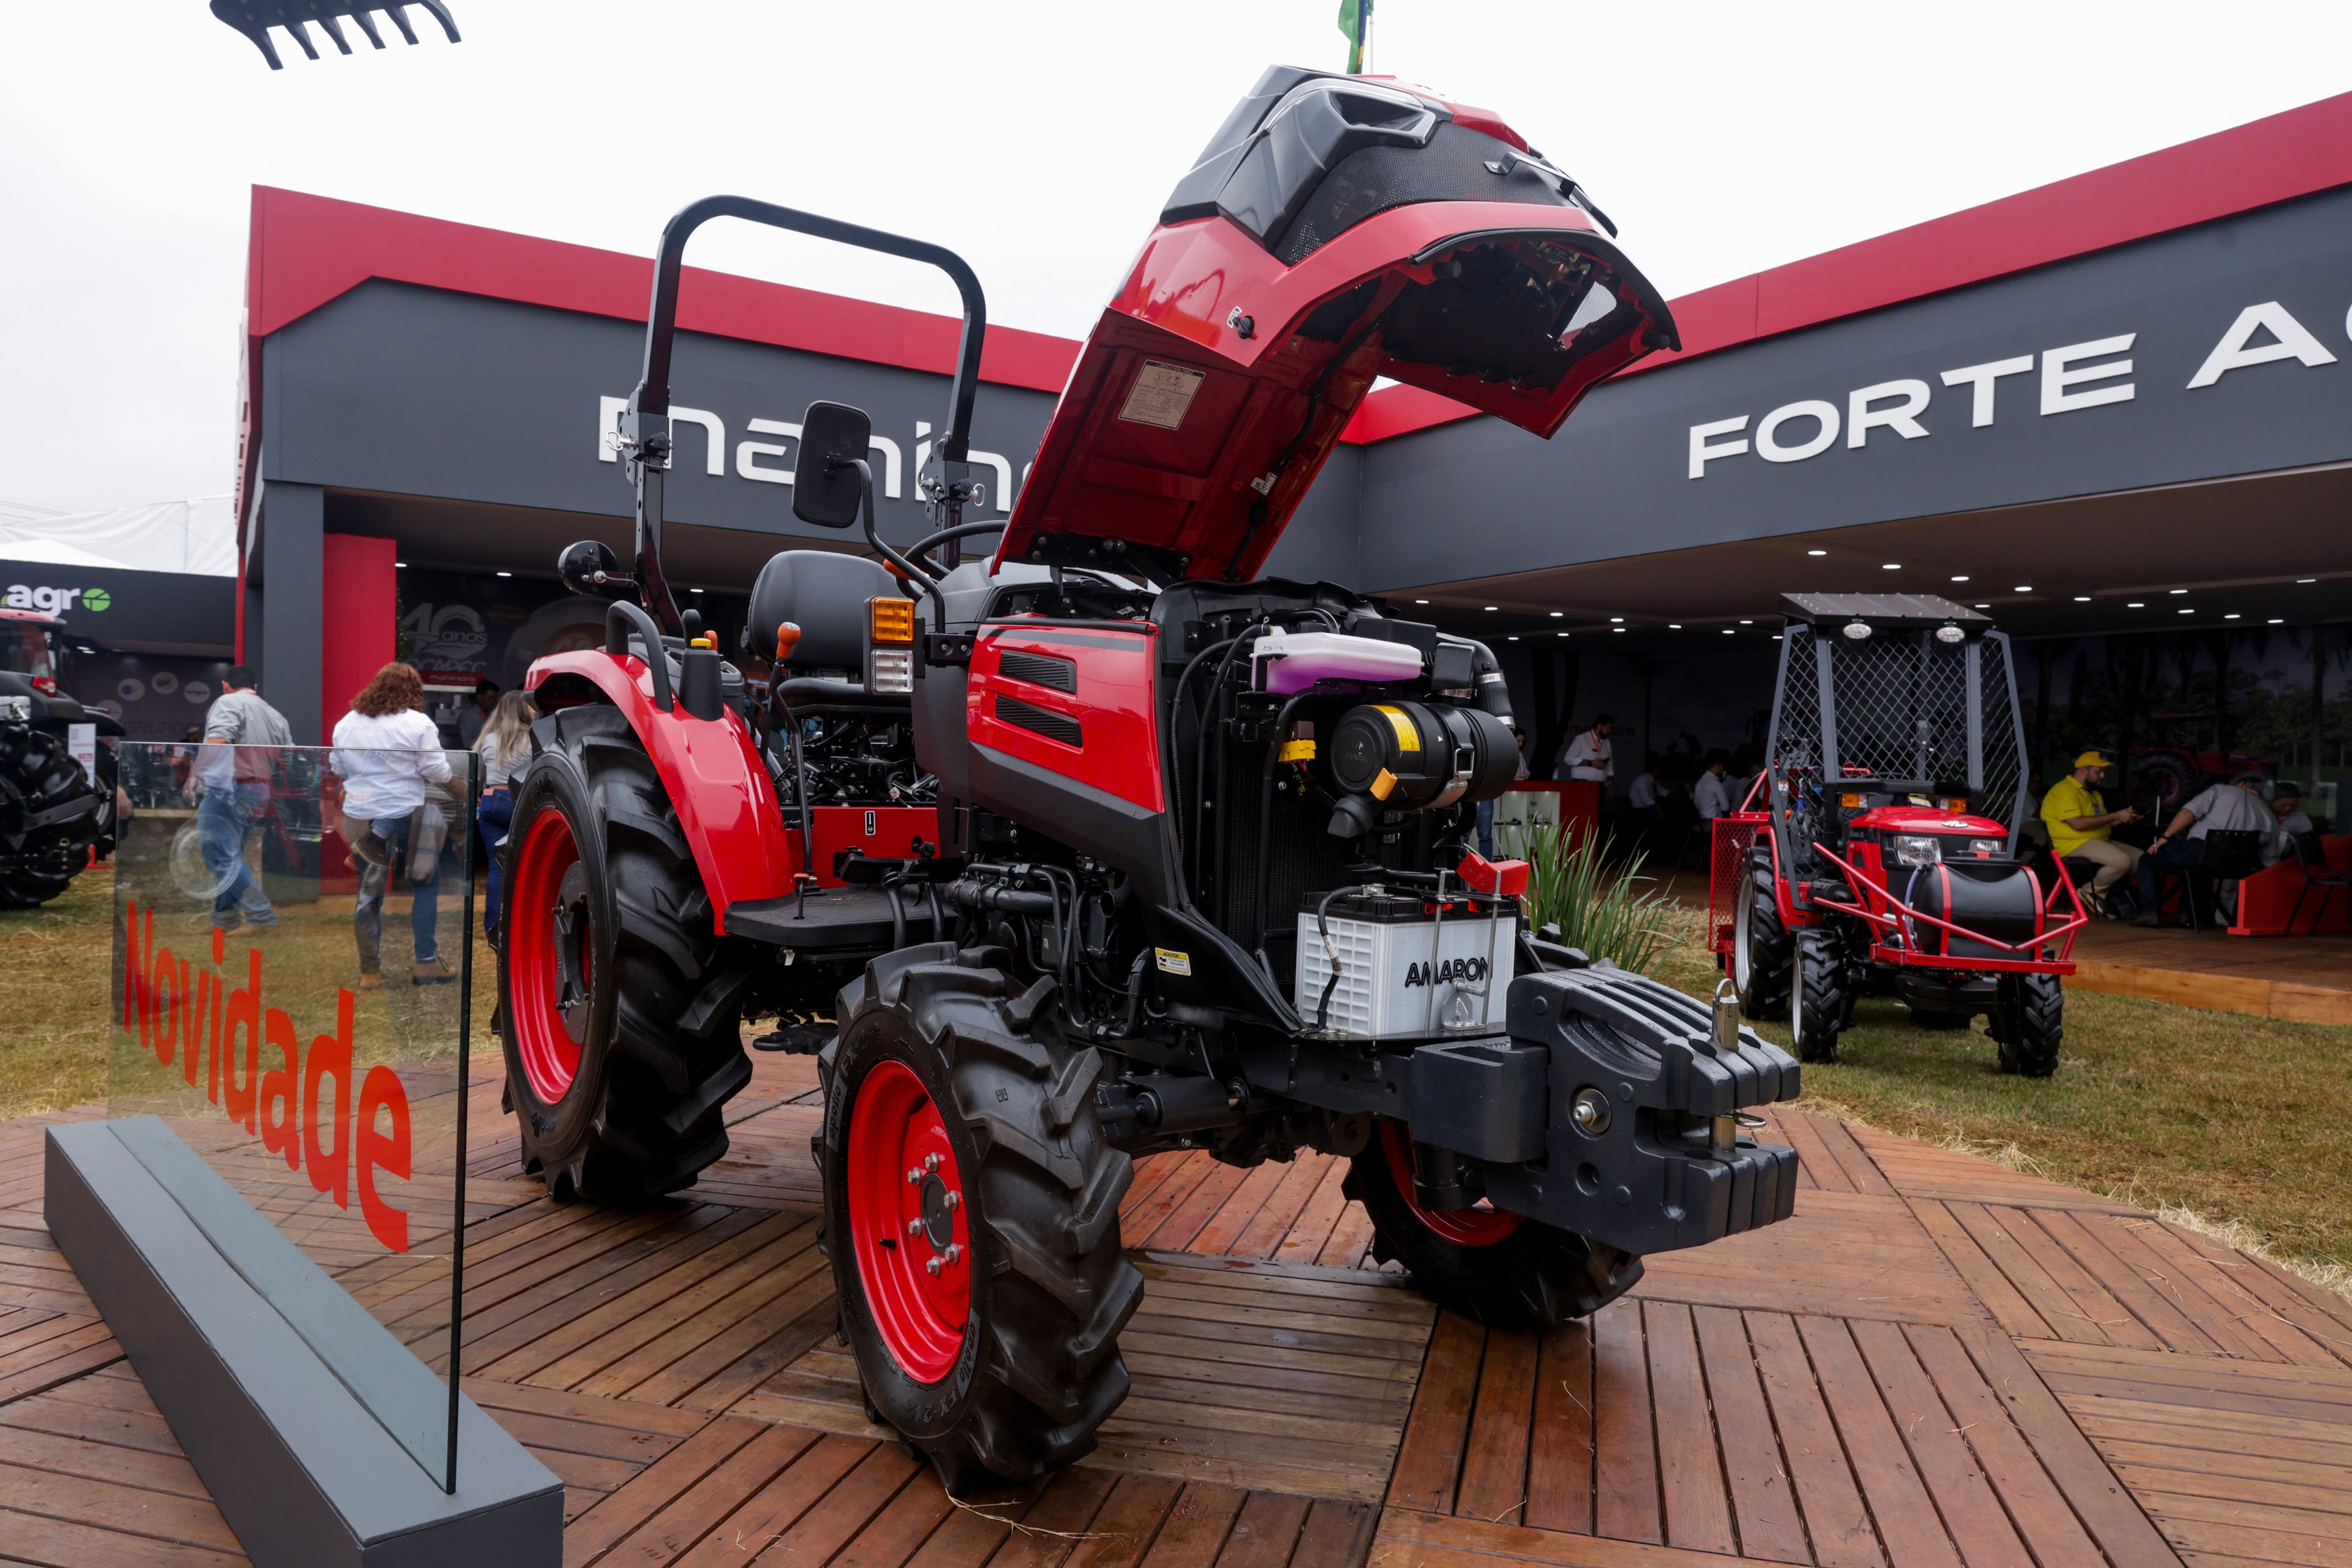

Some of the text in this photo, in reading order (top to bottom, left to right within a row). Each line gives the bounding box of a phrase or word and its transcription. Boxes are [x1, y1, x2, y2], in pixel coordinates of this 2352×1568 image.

[1689, 301, 2352, 480] FORTE A
[441, 631, 488, 643] anos
[1405, 956, 1493, 988] AMARON
[124, 900, 412, 1253] Novidade
